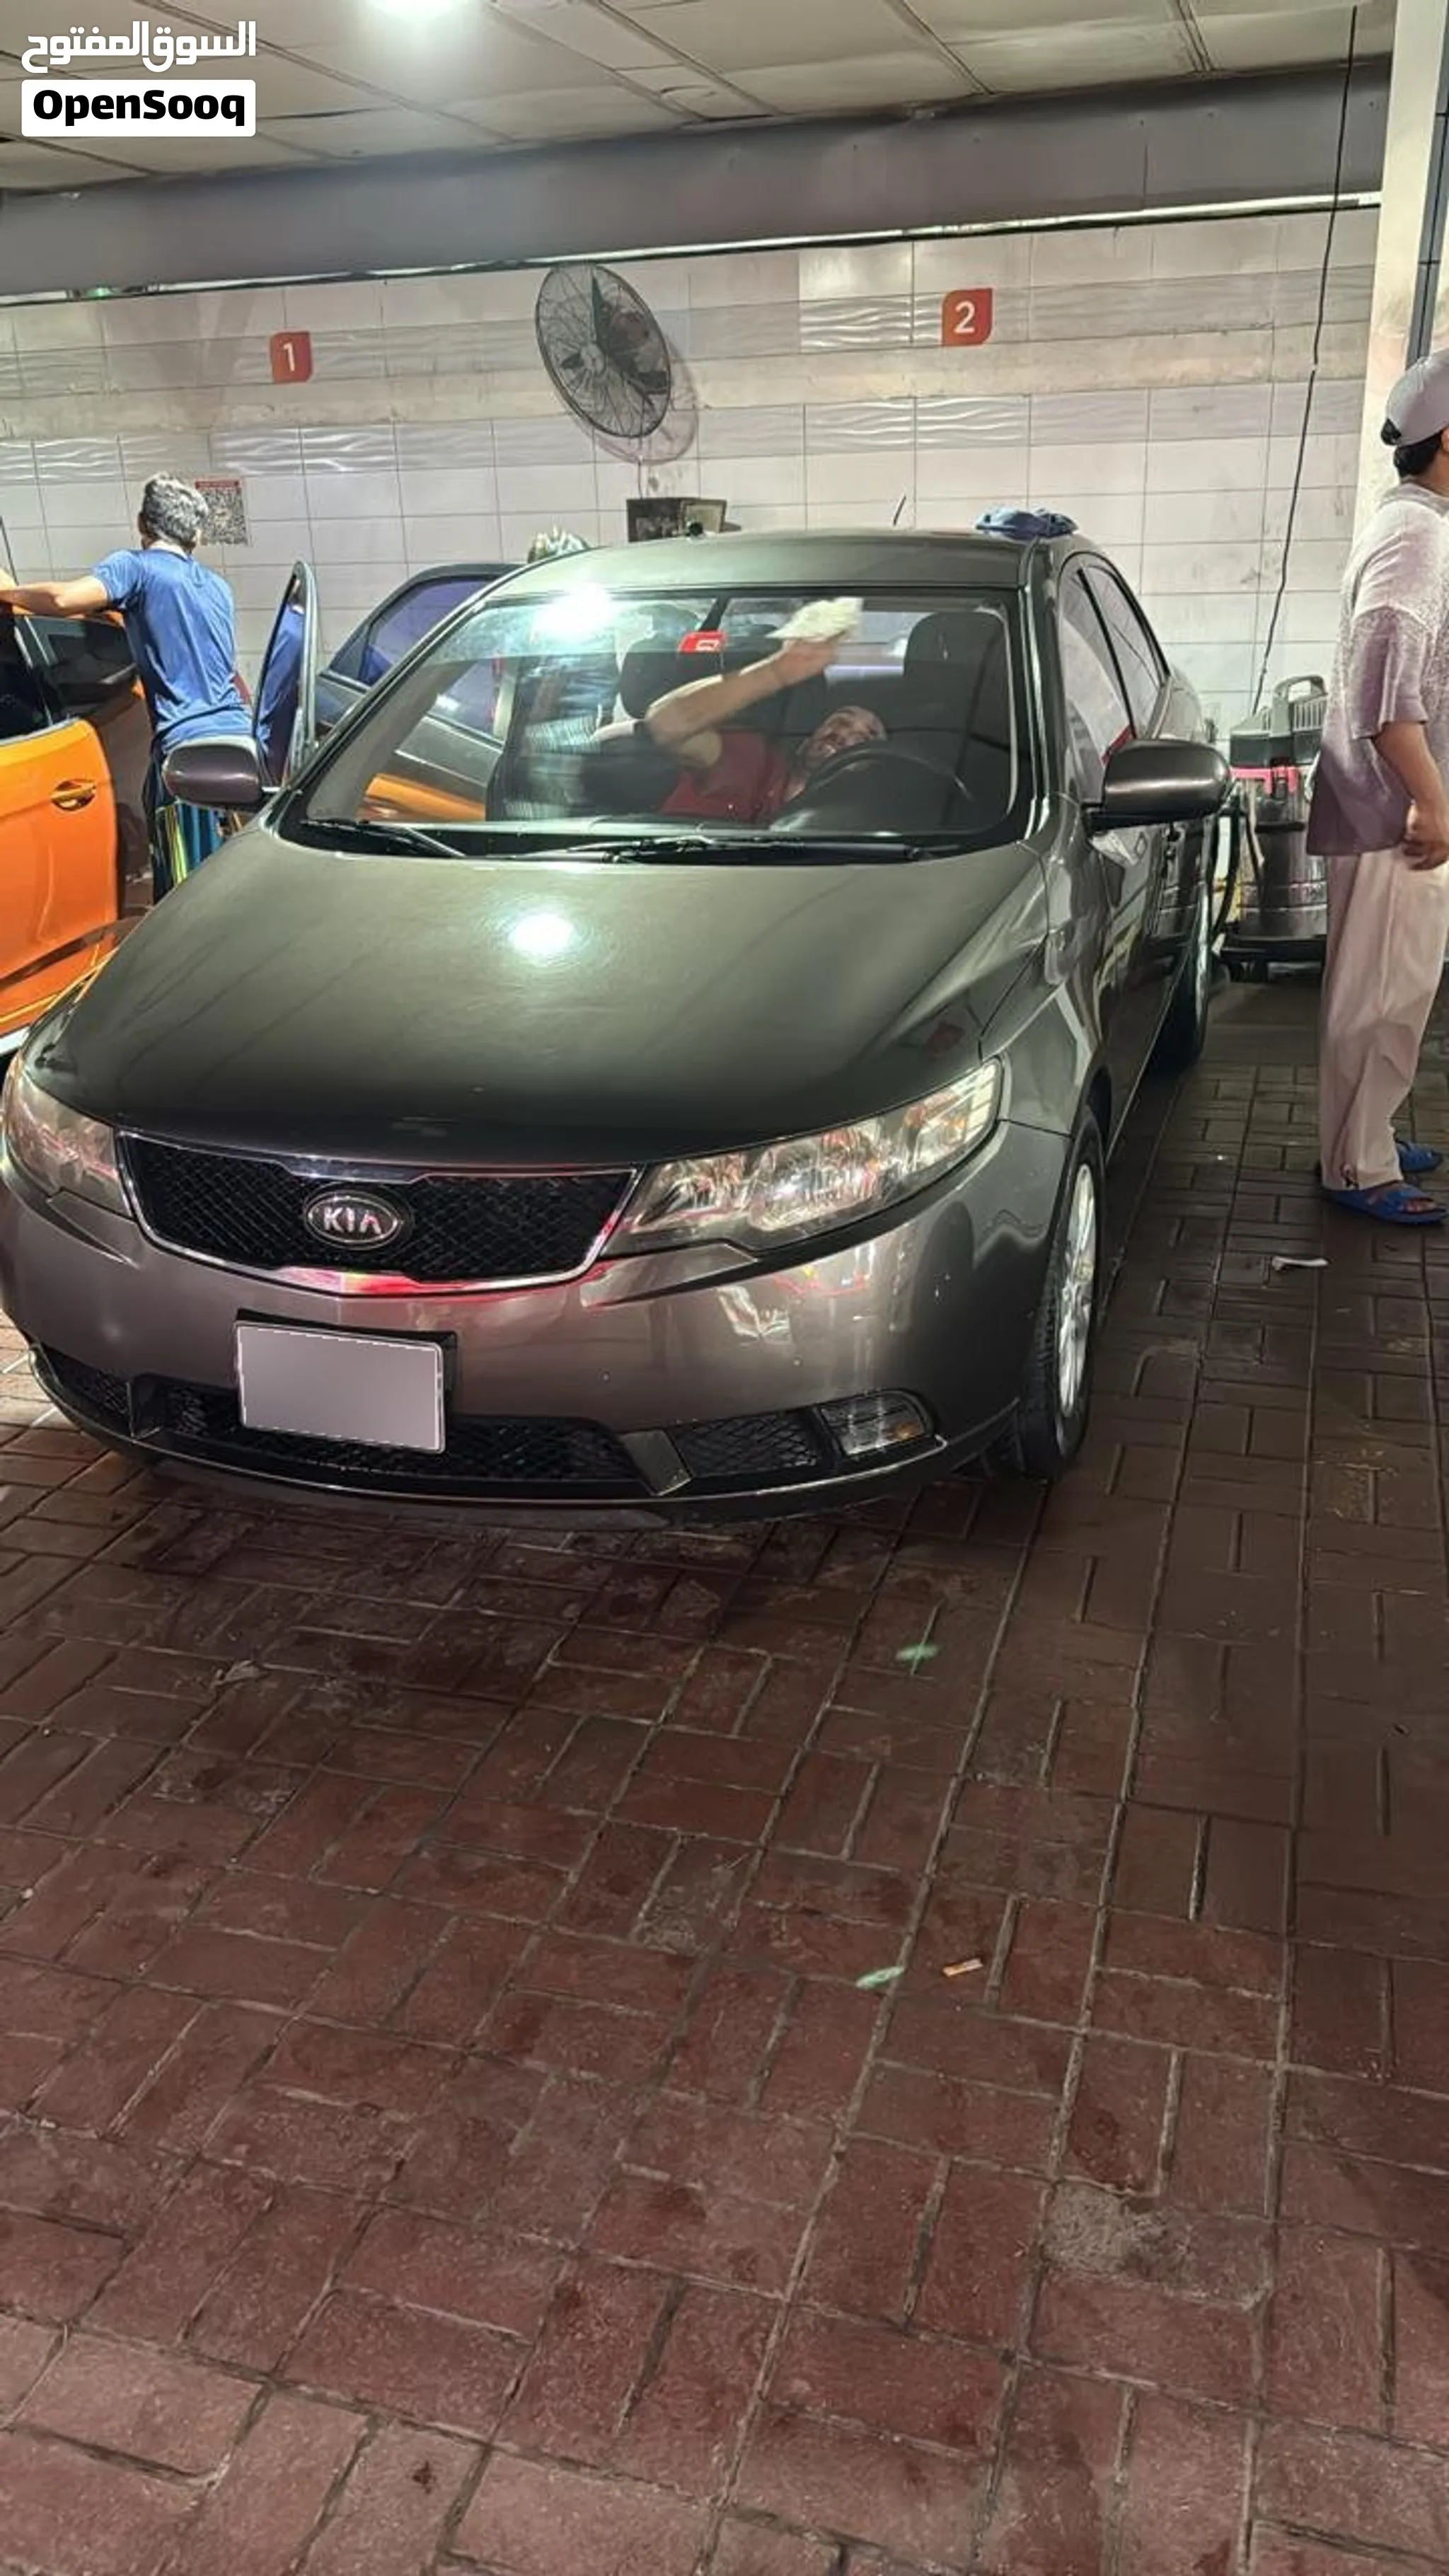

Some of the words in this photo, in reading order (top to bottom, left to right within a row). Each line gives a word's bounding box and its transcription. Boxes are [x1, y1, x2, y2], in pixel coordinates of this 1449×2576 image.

[954, 300, 975, 334] 2
[283, 342, 296, 371] 1
[323, 1206, 382, 1235] KIA
